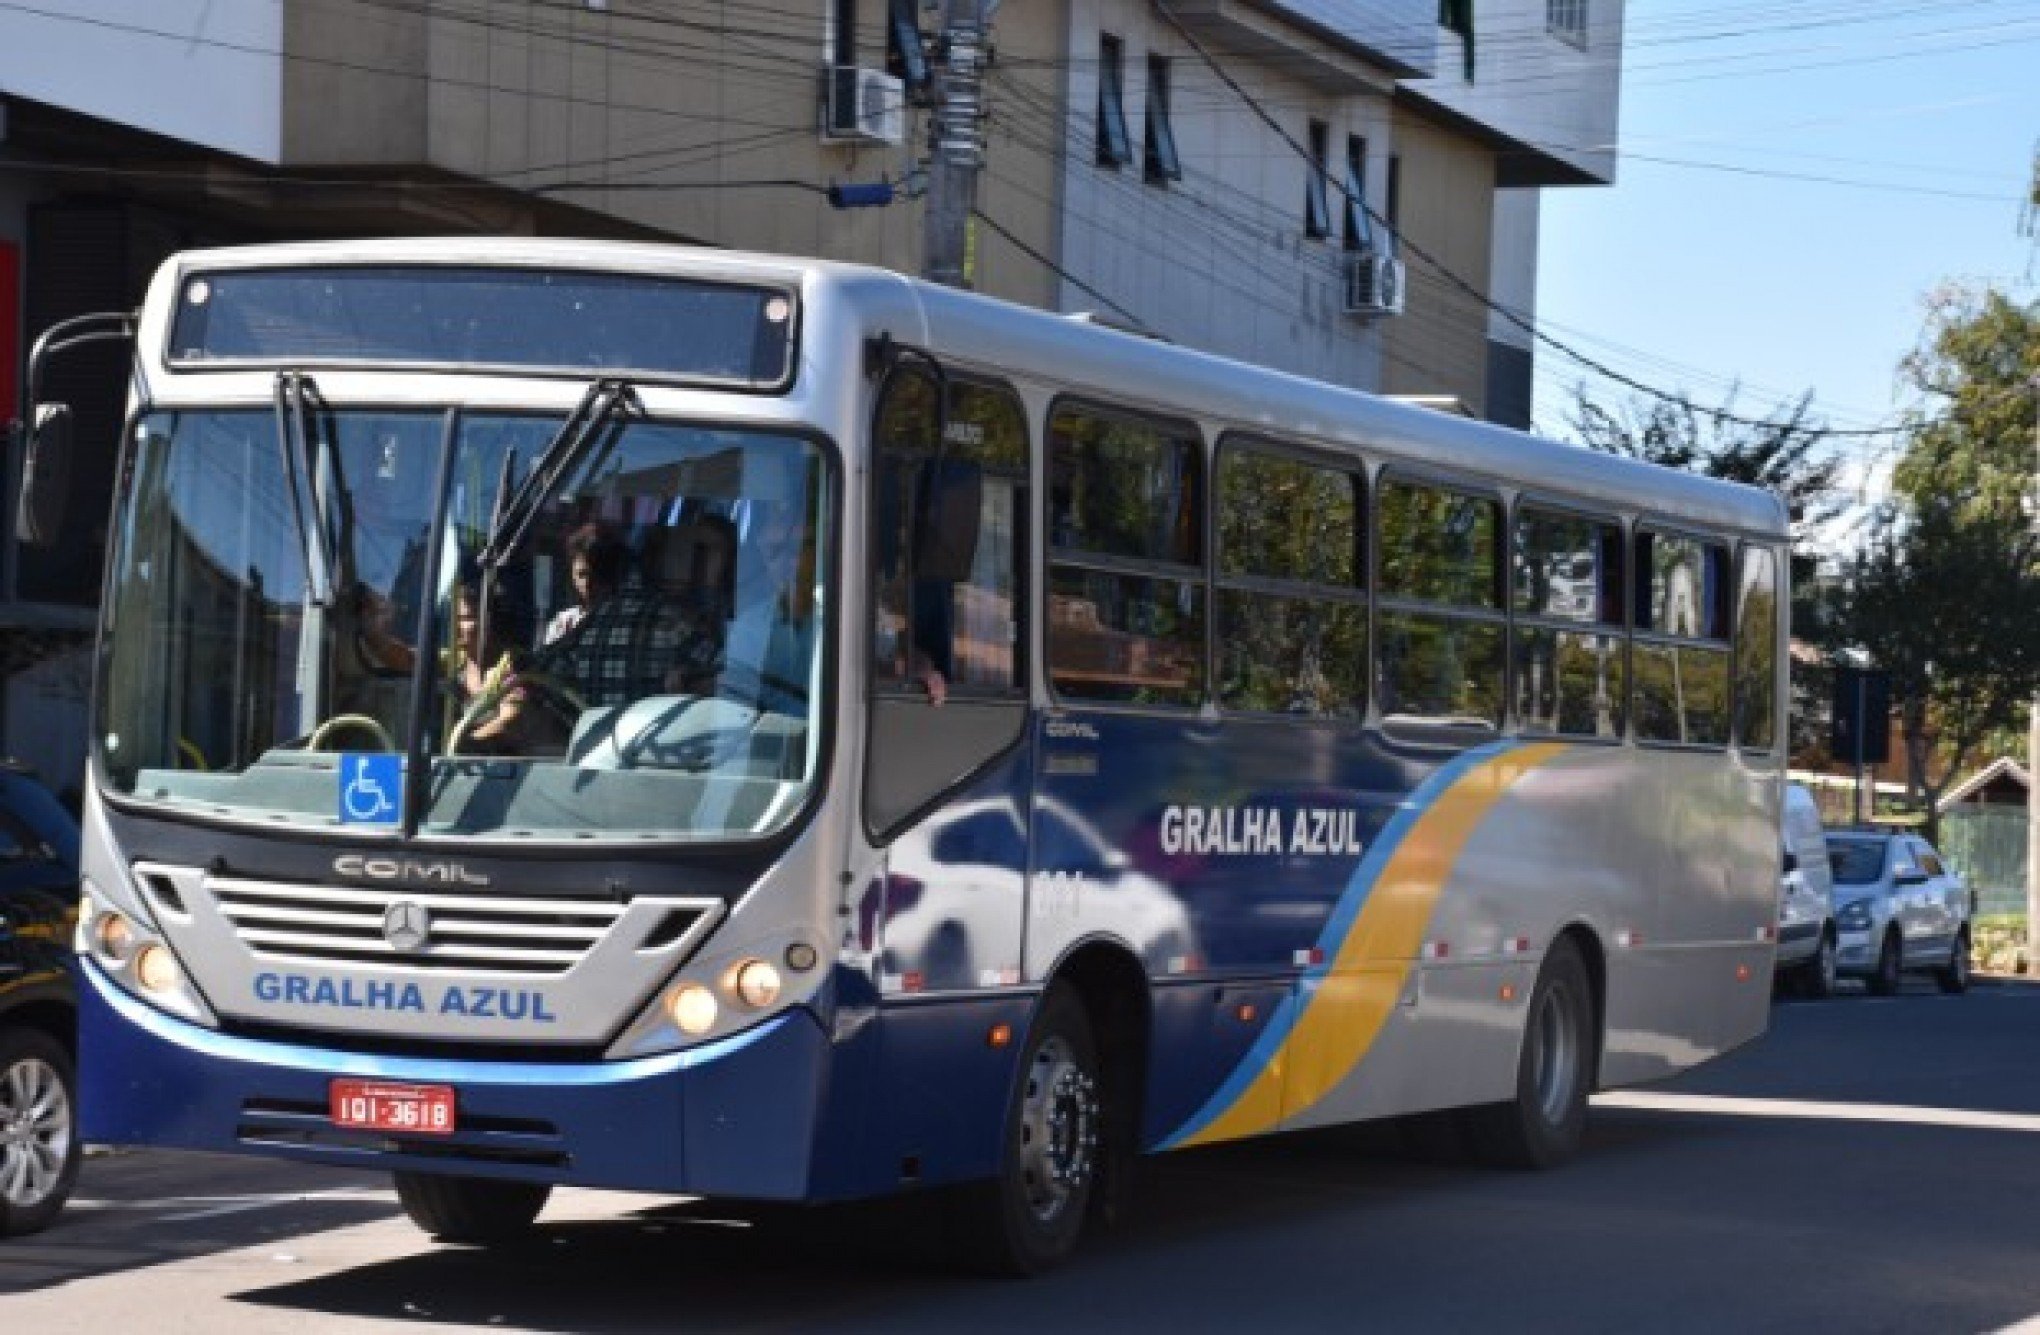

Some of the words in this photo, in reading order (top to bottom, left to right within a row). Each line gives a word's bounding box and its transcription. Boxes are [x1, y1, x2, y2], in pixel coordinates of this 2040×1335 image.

[1160, 805, 1281, 855] GRALHA
[1290, 808, 1362, 855] AZUL
[332, 855, 491, 885] COMIL
[252, 971, 425, 1013] GRALHA
[440, 986, 557, 1023] AZUL
